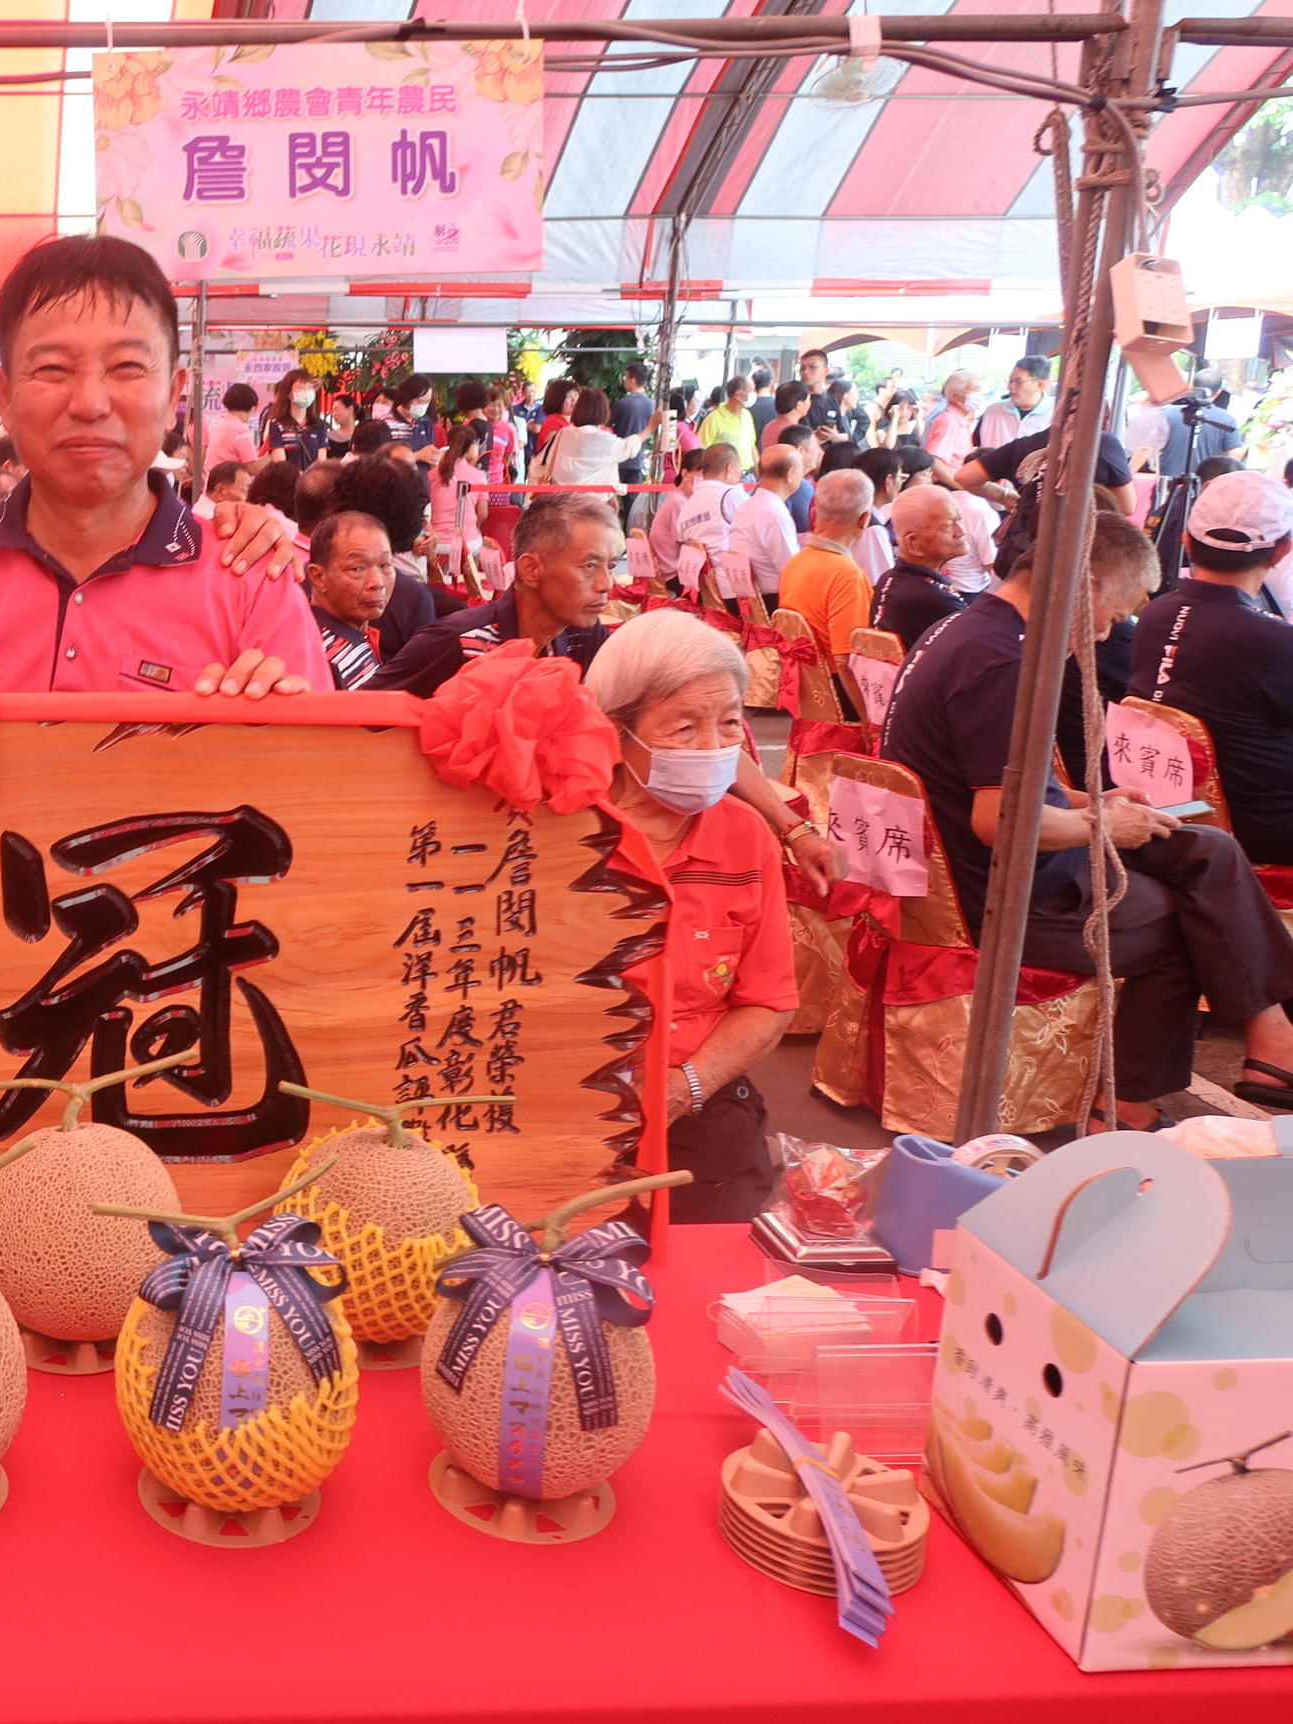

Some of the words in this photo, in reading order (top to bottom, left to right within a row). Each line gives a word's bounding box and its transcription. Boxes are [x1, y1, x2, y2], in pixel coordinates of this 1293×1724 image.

[180, 84, 457, 122] 永靖鄉農會青年農民
[181, 128, 458, 201] 詹閔帆
[1170, 606, 1192, 641] NUOVI
[1157, 645, 1178, 685] FILA
[1113, 733, 1186, 789] 來賓席
[254, 1269, 288, 1307] MISS
[284, 1305, 315, 1348] YOU
[452, 1333, 480, 1376] MISS
[472, 1295, 505, 1333] YOU
[177, 1347, 204, 1392] YOU
[559, 1308, 587, 1353] MISS
[573, 1356, 596, 1400] YOU
